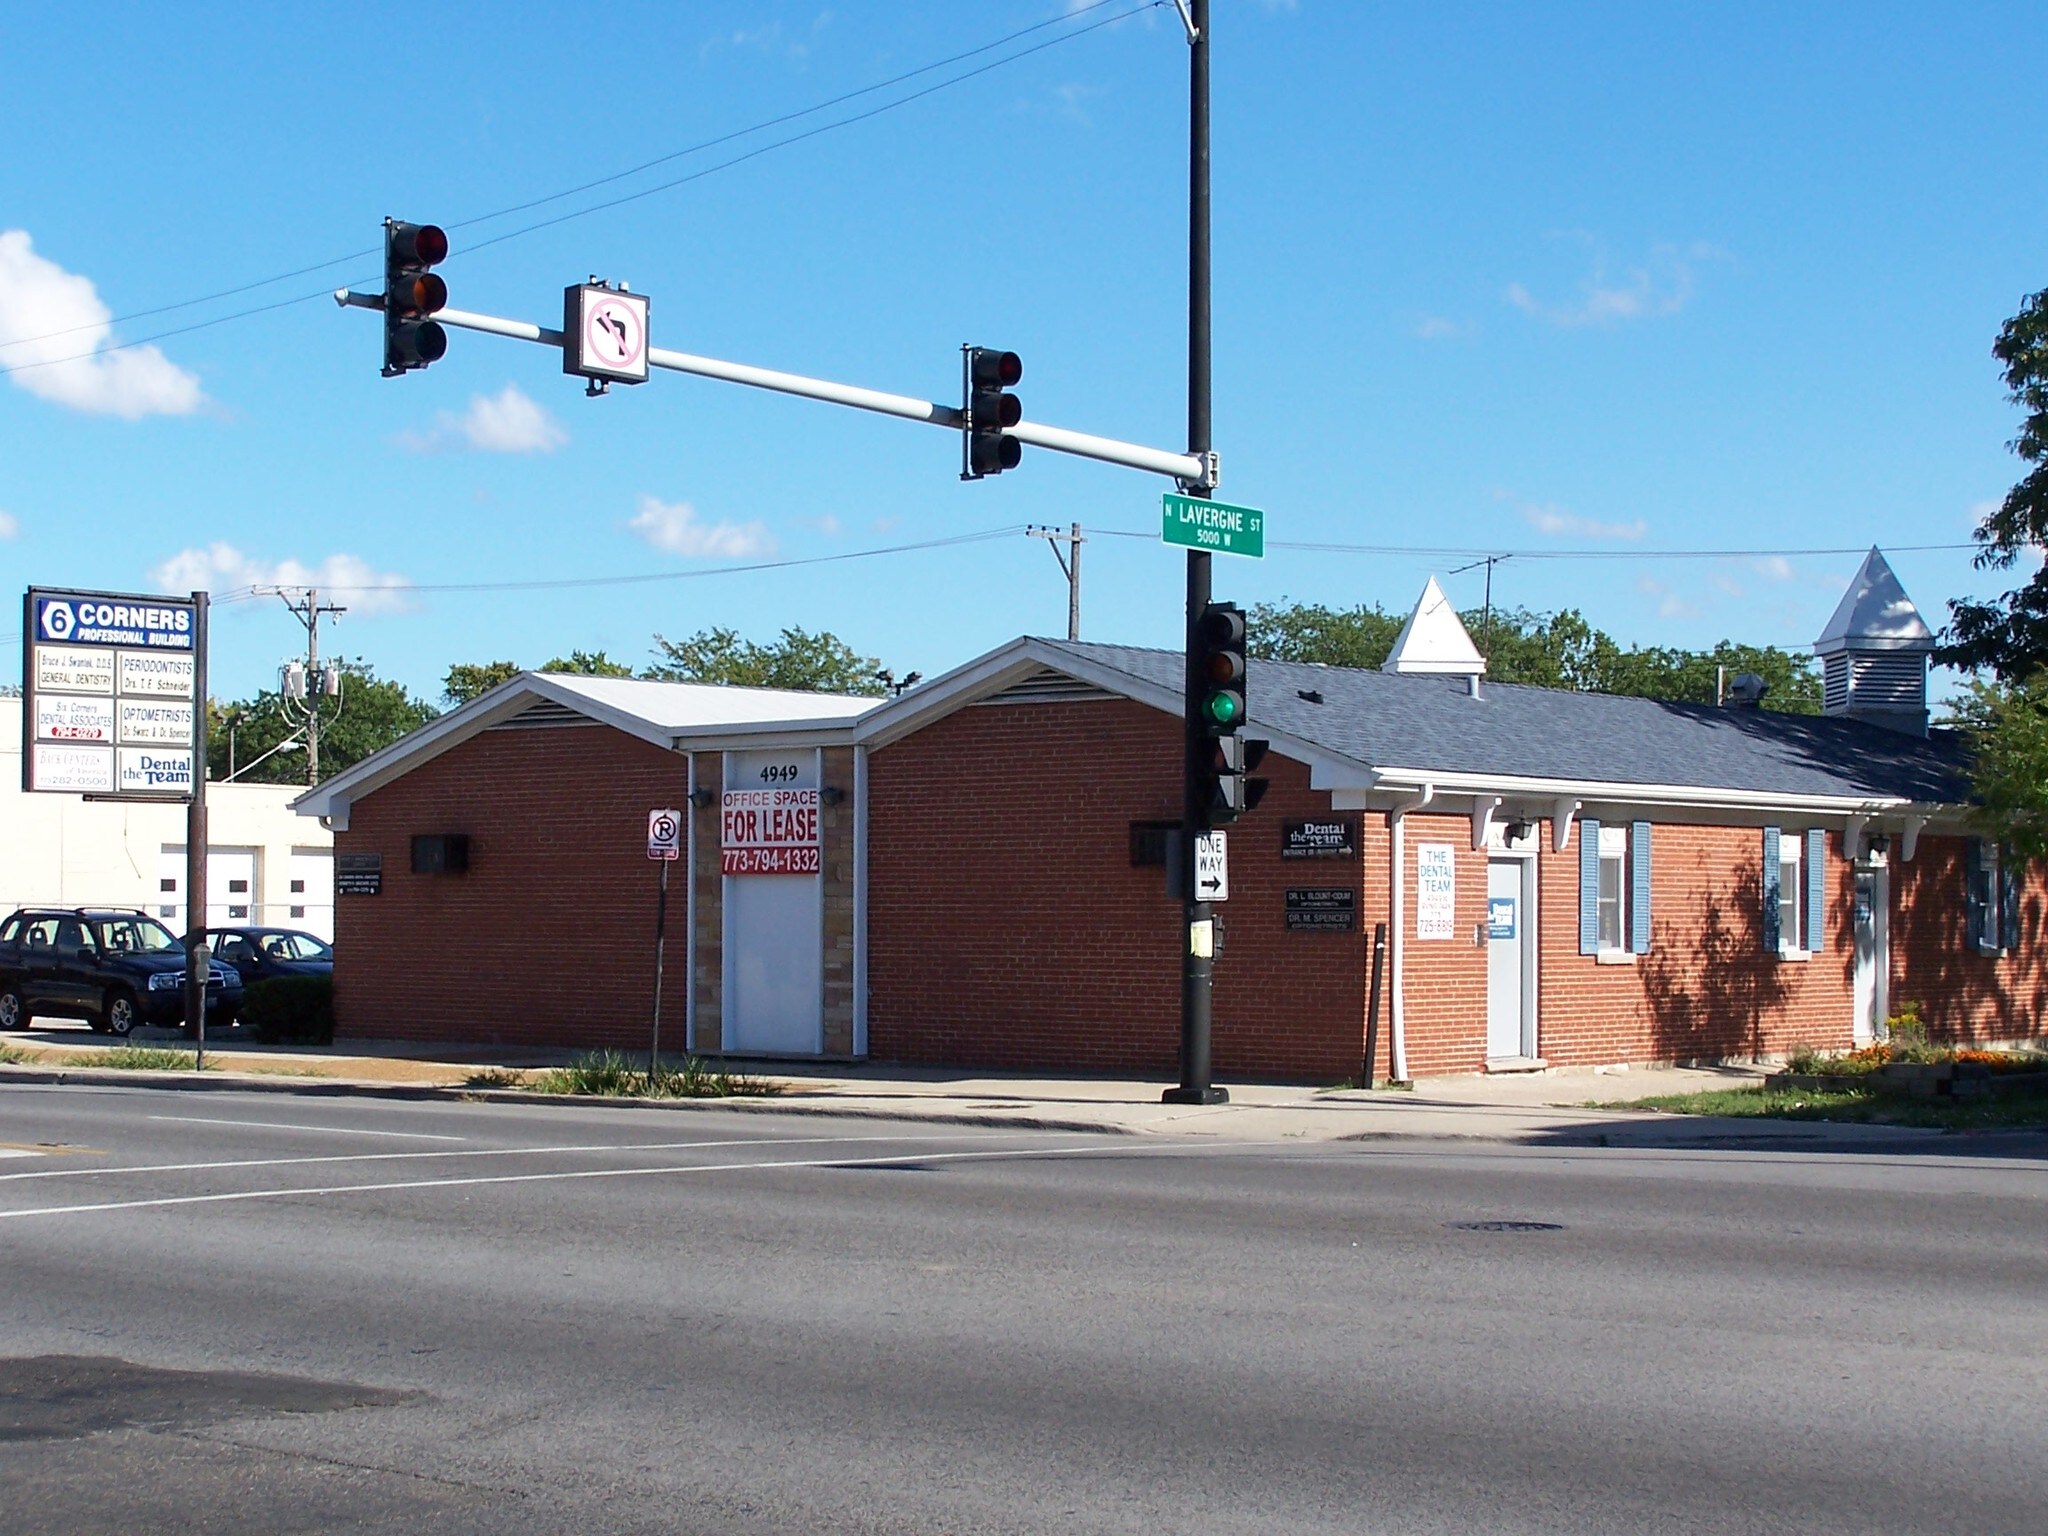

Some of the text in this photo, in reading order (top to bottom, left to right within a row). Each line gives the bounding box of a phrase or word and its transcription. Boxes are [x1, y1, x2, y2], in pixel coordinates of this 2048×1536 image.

[1165, 502, 1261, 532] N LAVERGNE ST
[1197, 529, 1232, 547] 5000 W
[51, 603, 190, 633] 6 CORNERS
[78, 627, 190, 648] PROFESSIONAL BUILDING
[124, 658, 192, 675] PERIODONTISTS
[41, 672, 111, 686] GENERAL DENTISTRY
[40, 713, 112, 727] DENTAL ASSOCIATES
[124, 707, 192, 723] OPTOMETRISTS
[141, 756, 190, 771] Dental
[123, 767, 190, 785] the Team
[760, 765, 798, 783] 4949
[723, 790, 817, 807] OFFICE SPACE
[724, 808, 817, 843] FOR LEASE
[1304, 823, 1345, 835] Dental
[1290, 830, 1306, 842] the
[1200, 837, 1222, 853] ONE
[723, 848, 819, 872] 773-794-1332
[1199, 856, 1223, 871] WAY
[1426, 850, 1447, 863] THE
[1420, 865, 1453, 878] DENTAL
[1425, 879, 1451, 892] TEAM
[1314, 914, 1351, 923] SPENCER
